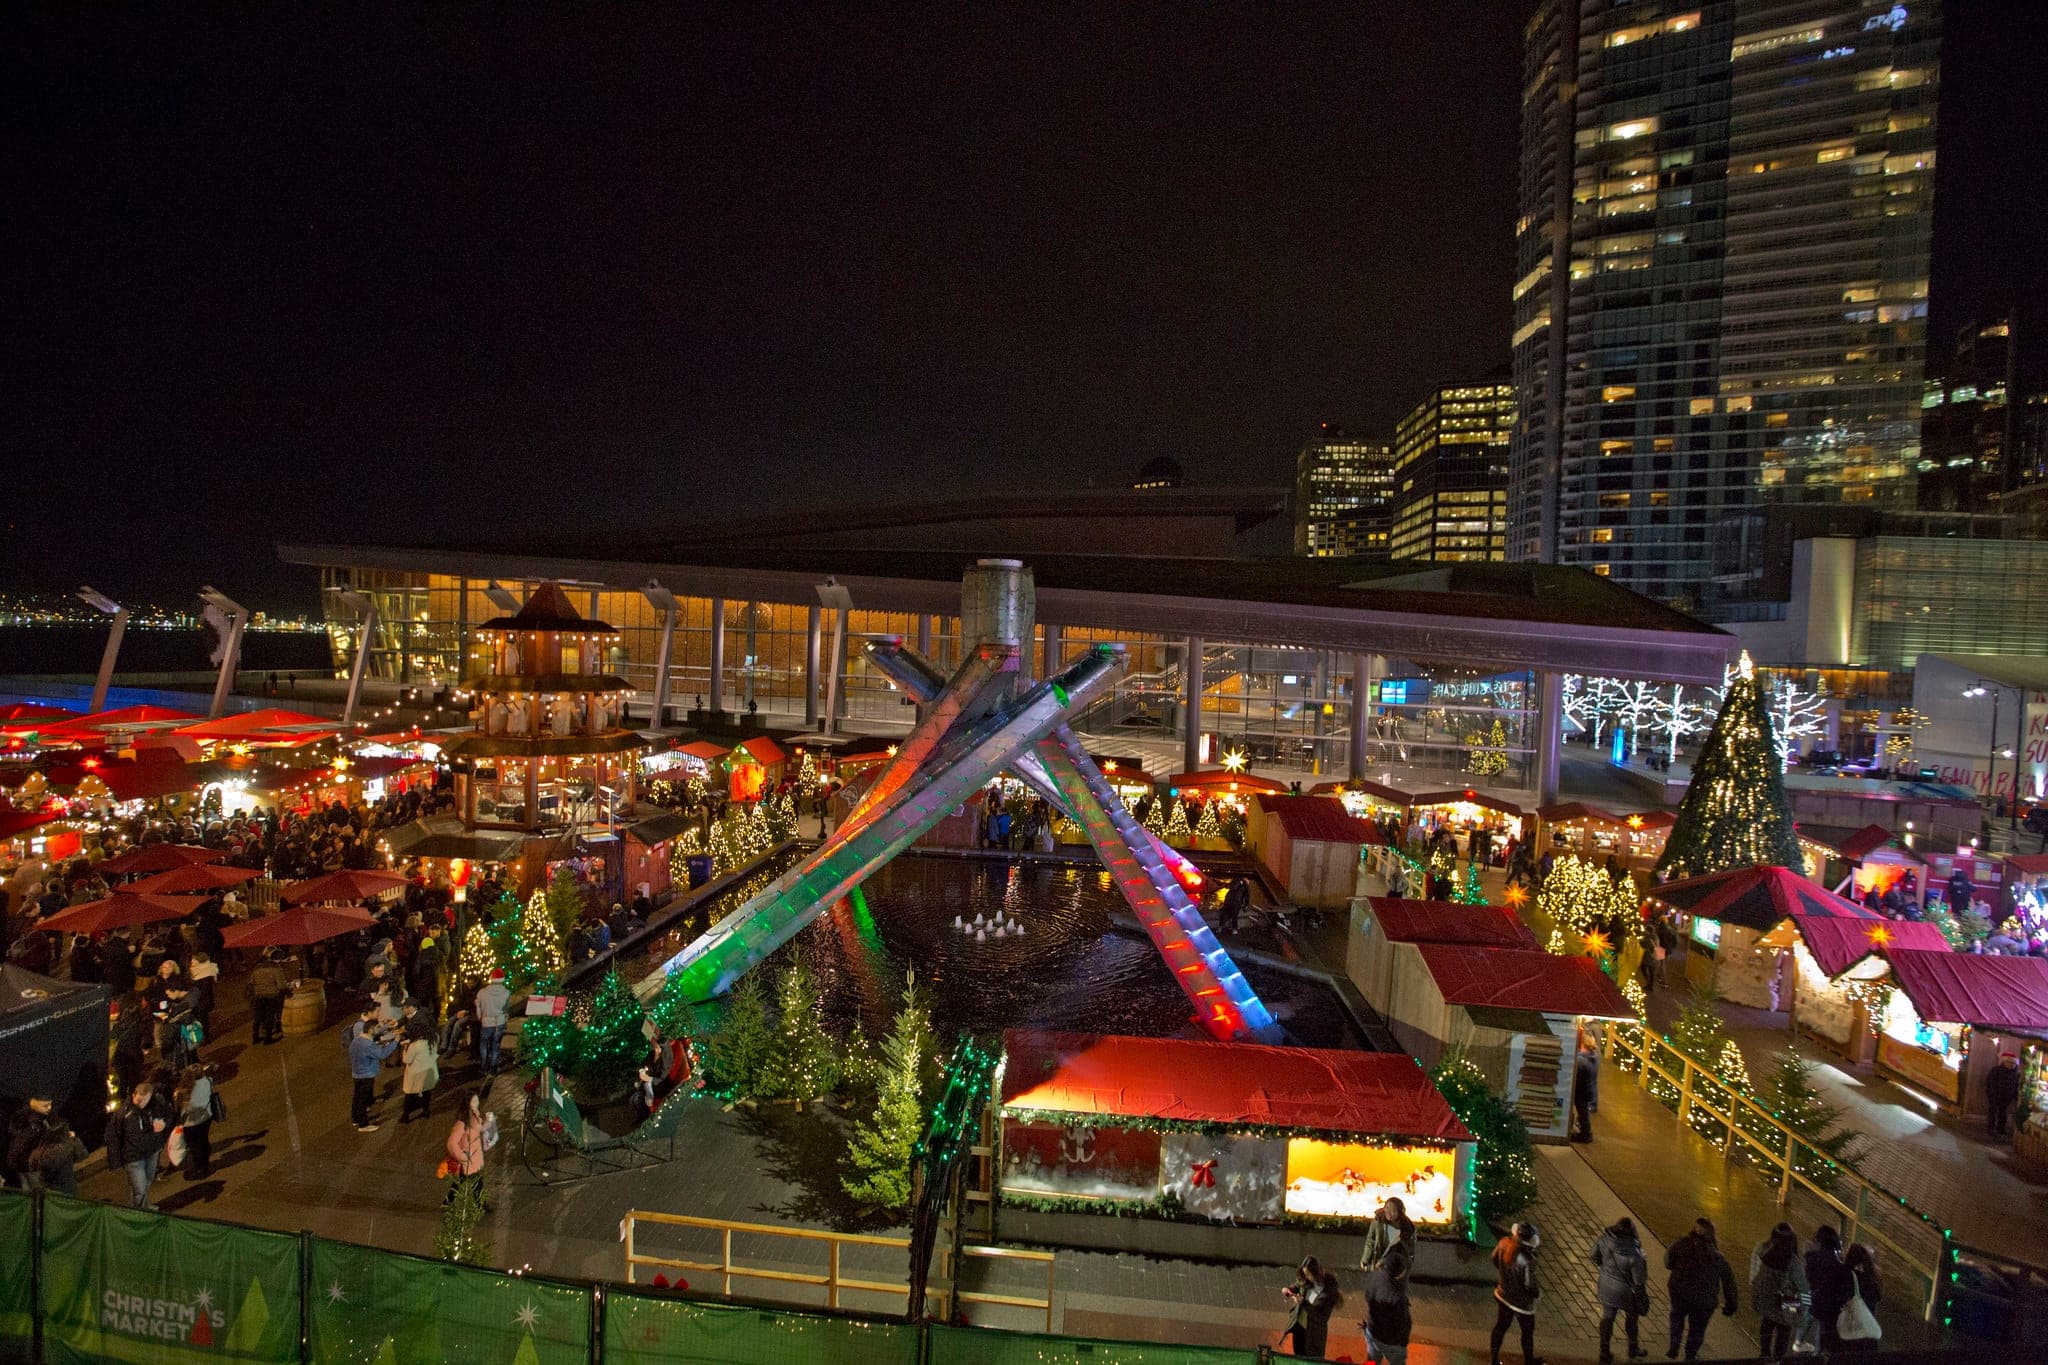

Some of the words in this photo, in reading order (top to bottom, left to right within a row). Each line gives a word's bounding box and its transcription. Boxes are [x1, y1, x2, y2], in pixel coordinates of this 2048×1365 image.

[106, 1277, 189, 1305] NCOUER
[101, 1308, 190, 1341] MARKET
[103, 1288, 225, 1330] CHRISTMAS
